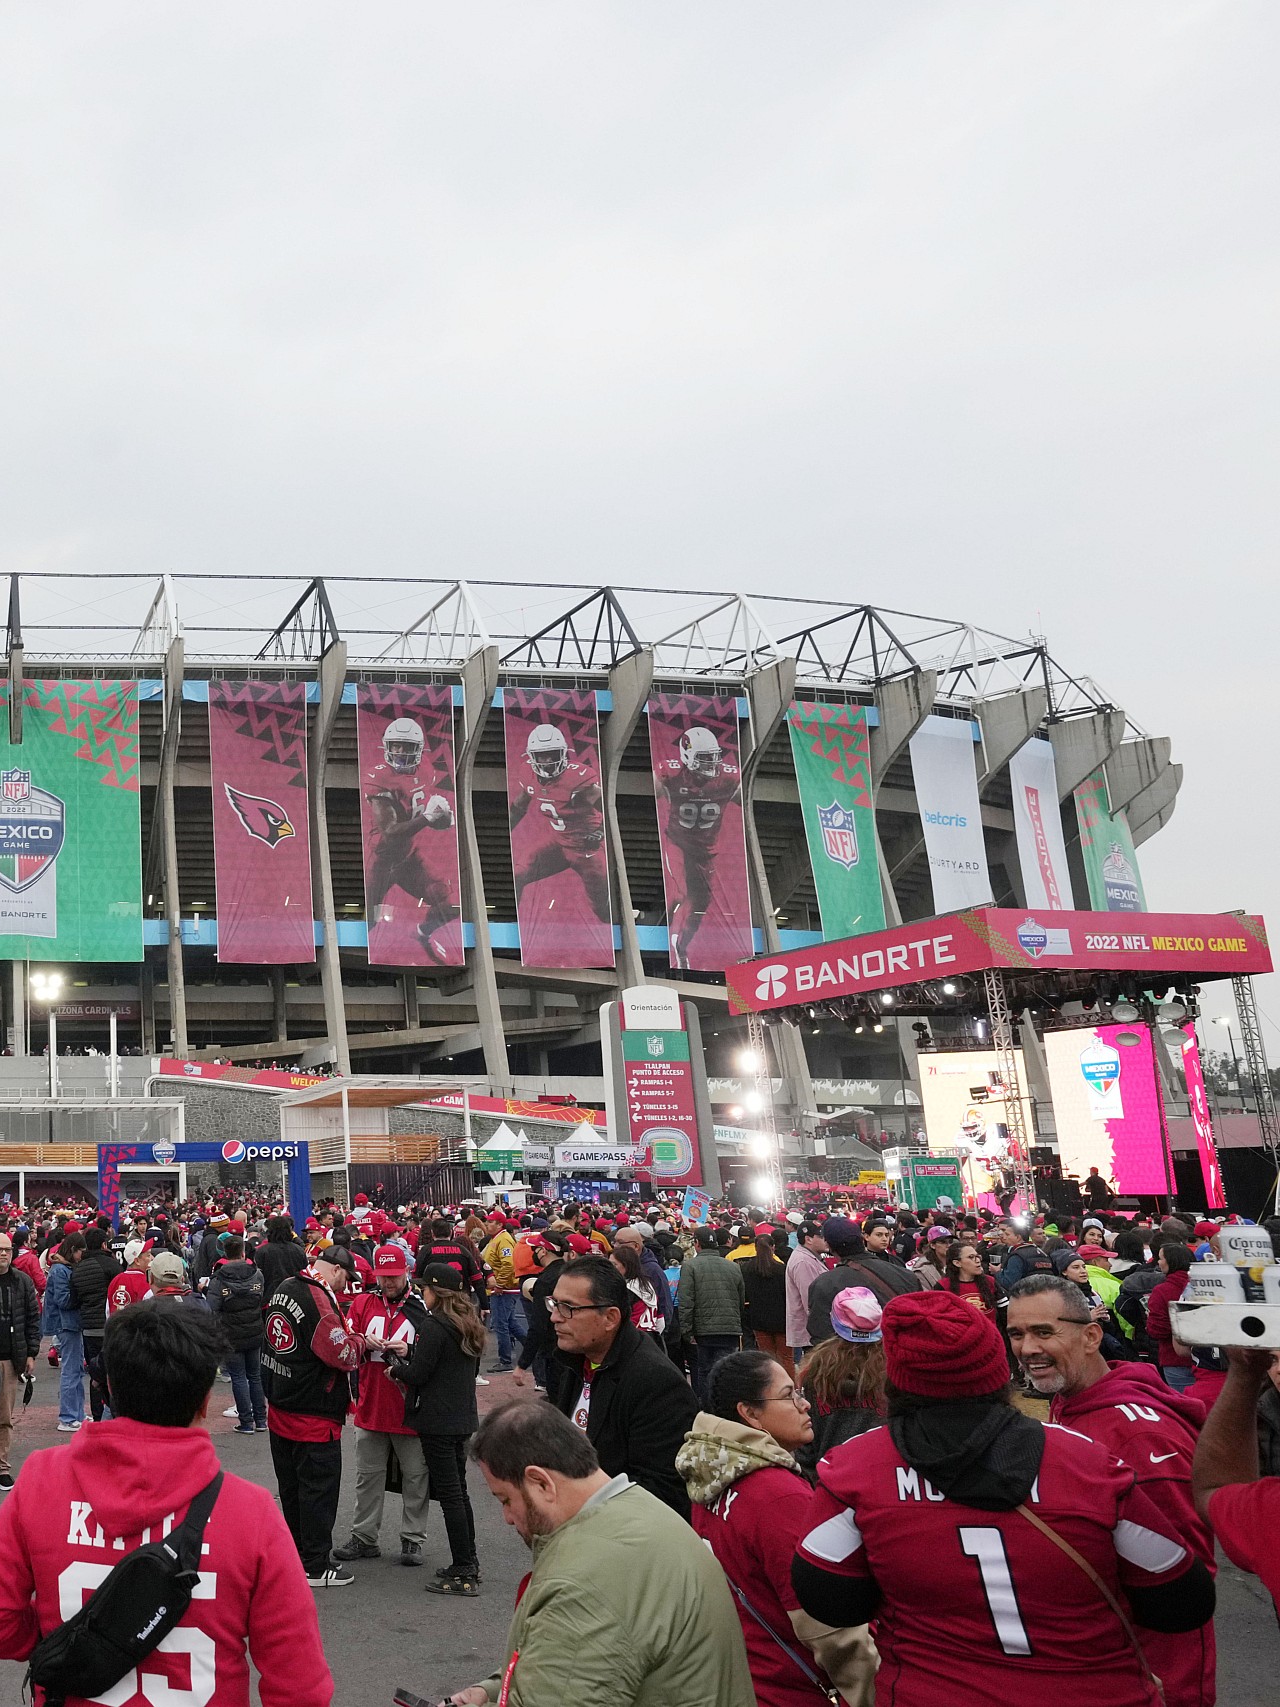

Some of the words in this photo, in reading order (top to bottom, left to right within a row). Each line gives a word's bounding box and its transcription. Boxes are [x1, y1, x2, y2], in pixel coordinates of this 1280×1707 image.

[4, 783, 28, 799] NFL
[540, 803, 567, 831] 3
[679, 803, 721, 829] 99
[925, 809, 967, 828] betcris
[3, 841, 31, 849] GAME
[826, 829, 856, 862] NFL
[1, 910, 48, 919] BANORTE
[1085, 935, 1120, 950] 2022
[1123, 935, 1150, 950] NFL
[1151, 936, 1205, 952] MEXICO
[1208, 937, 1248, 953] GAME
[795, 934, 957, 992] BANORTE
[85, 1006, 131, 1015] CARDIALS
[630, 1004, 673, 1012] Orientación
[649, 1045, 663, 1053] NFL
[928, 1066, 938, 1076] 71
[290, 1076, 321, 1088] WELCO
[444, 1095, 464, 1105] GAM
[247, 1141, 299, 1161] pepsi
[431, 1246, 461, 1255] MONTANA
[1244, 1250, 1269, 1258] Extra
[378, 1255, 397, 1266] 49ers
[287, 1298, 306, 1324] BOWL
[957, 1526, 1032, 1656] 1
[136, 1612, 163, 1641] Timberland
